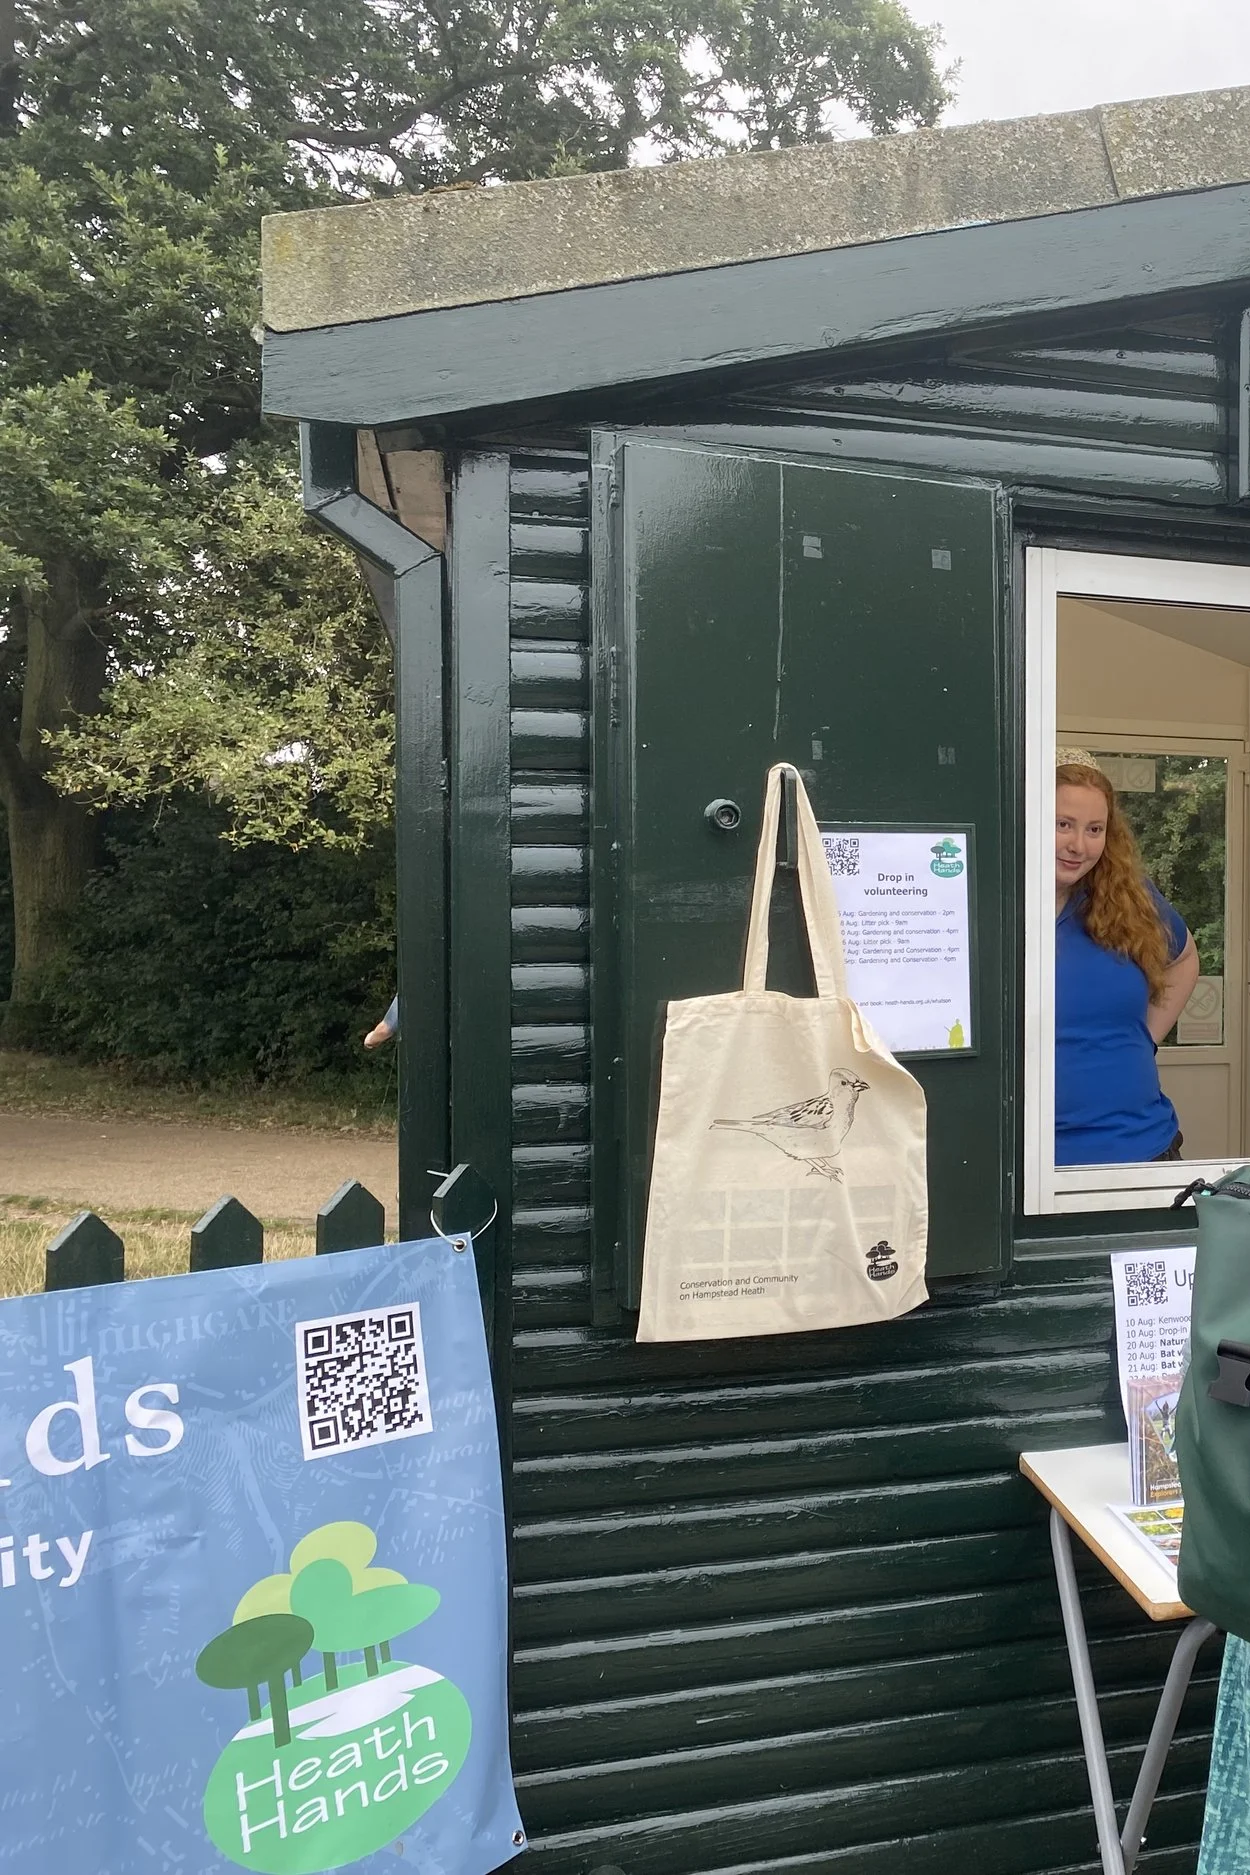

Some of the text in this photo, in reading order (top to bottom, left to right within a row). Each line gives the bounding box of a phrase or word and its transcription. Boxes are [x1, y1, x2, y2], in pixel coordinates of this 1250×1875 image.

[878, 873, 914, 883] Drop in
[864, 887, 928, 897] volunteering
[858, 910, 888, 918] Gardening
[846, 929, 860, 937] Aug:
[847, 948, 859, 956] Aug:
[869, 1264, 895, 1272] Heath
[869, 1269, 896, 1277] Hands
[680, 1275, 799, 1290] Conservation and Community
[692, 1289, 739, 1300] Hampstead
[741, 1286, 765, 1296] Heath
[1126, 1318, 1135, 1327] 10
[1138, 1318, 1155, 1326] Aug:
[1127, 1330, 1136, 1338] 10
[1159, 1327, 1187, 1336] Drop-in
[1127, 1341, 1136, 1350] 20
[1139, 1341, 1157, 1349] Aug:
[1128, 1350, 1175, 1361] 20 Aug: Bat
[1128, 1361, 1176, 1372] 21 Aug: Bat
[0, 1355, 185, 1488] ds
[235, 1711, 436, 1812] Heath
[239, 1751, 450, 1854] Hands
